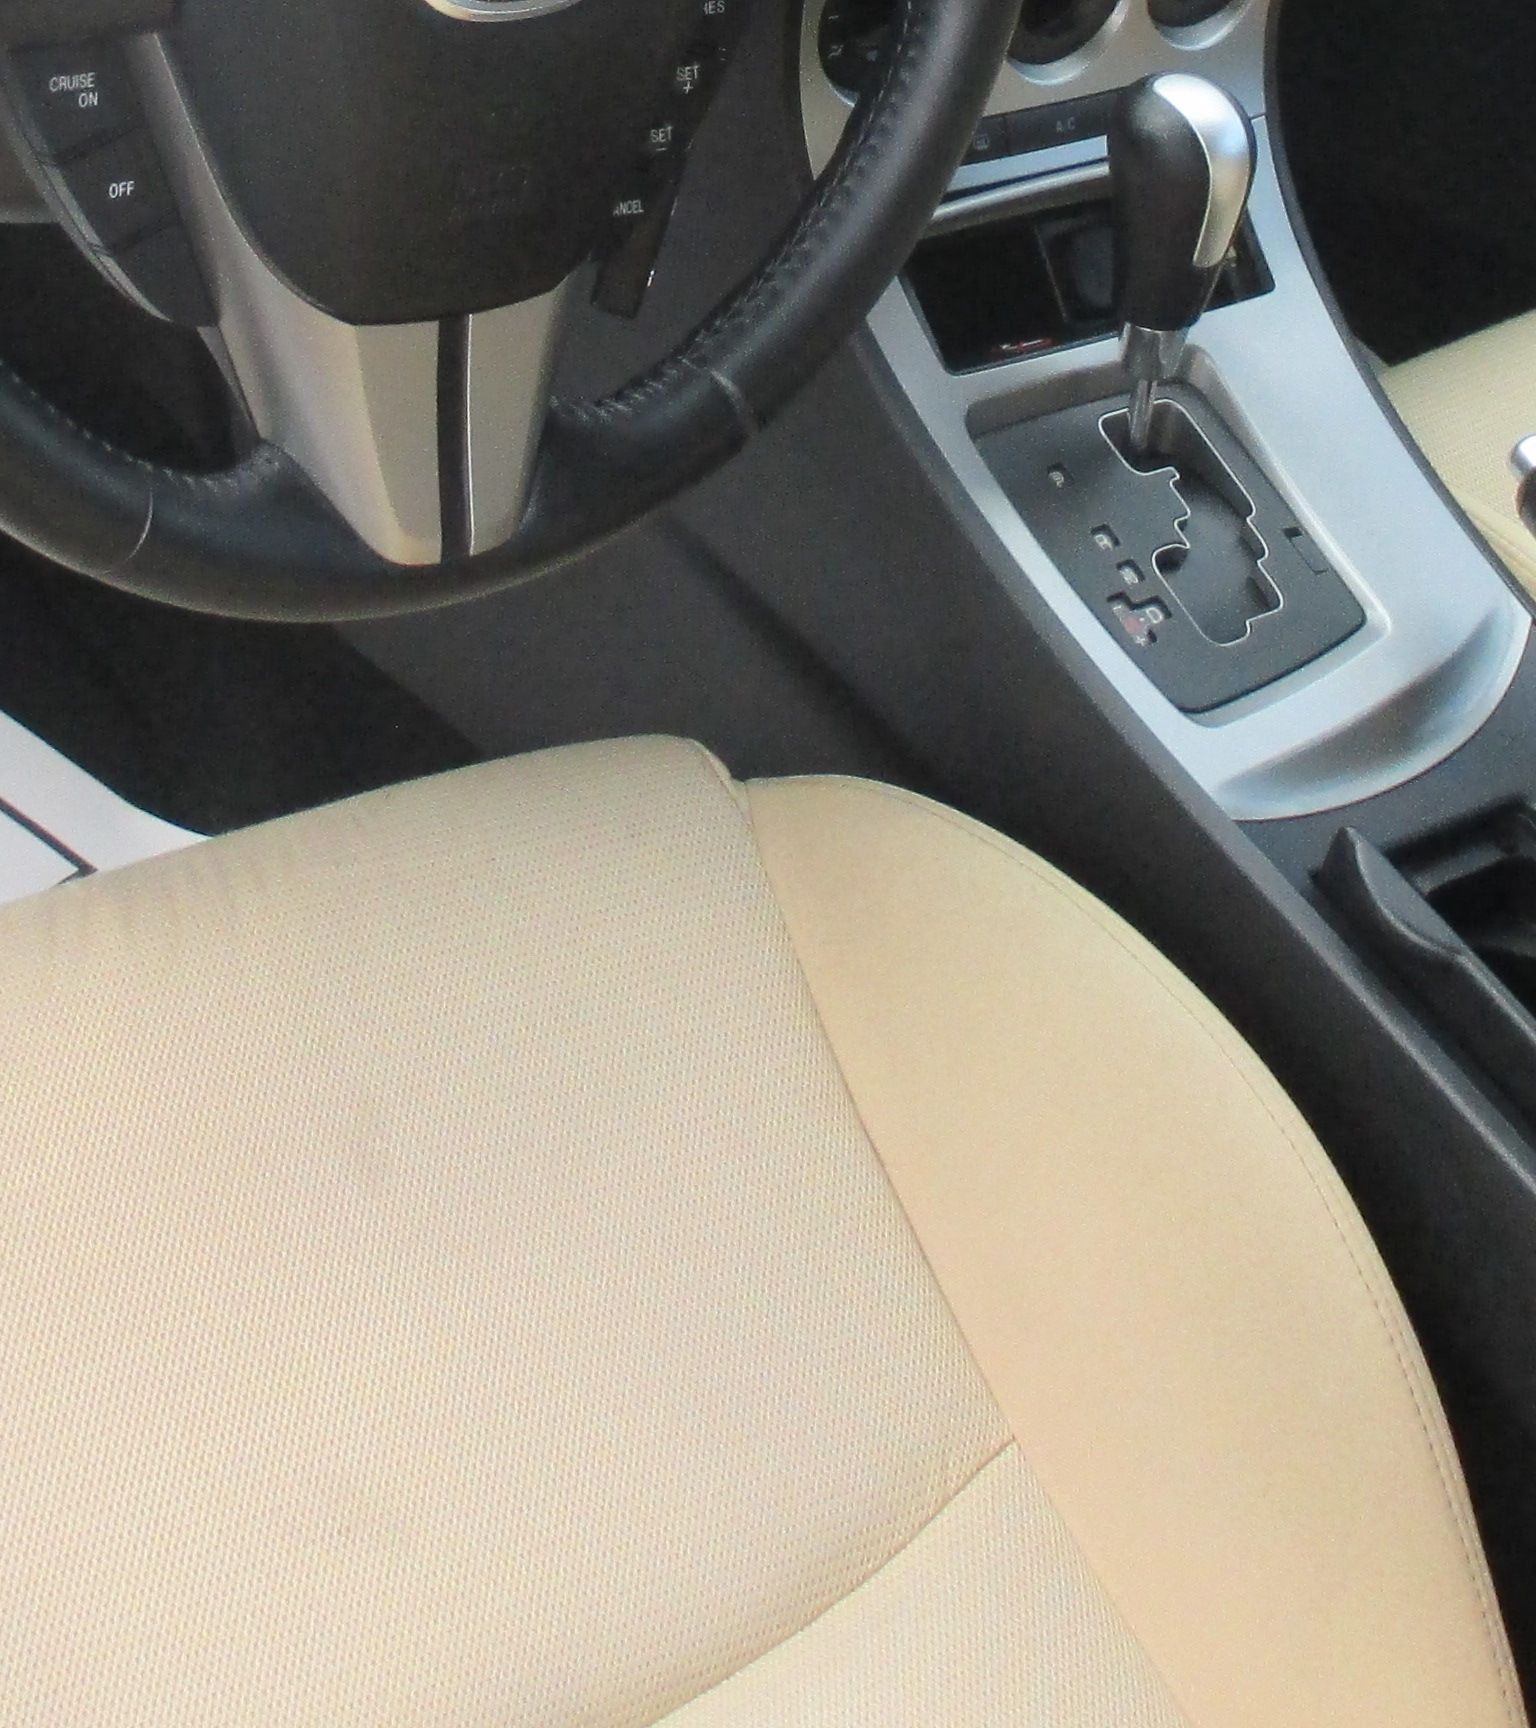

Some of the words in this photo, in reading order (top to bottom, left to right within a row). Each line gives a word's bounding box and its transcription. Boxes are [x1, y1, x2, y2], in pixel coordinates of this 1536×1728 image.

[676, 62, 700, 81] SET
[49, 72, 96, 93] CRUISE
[78, 91, 98, 108] ON
[650, 125, 673, 143] SET
[108, 180, 136, 199] OFF
